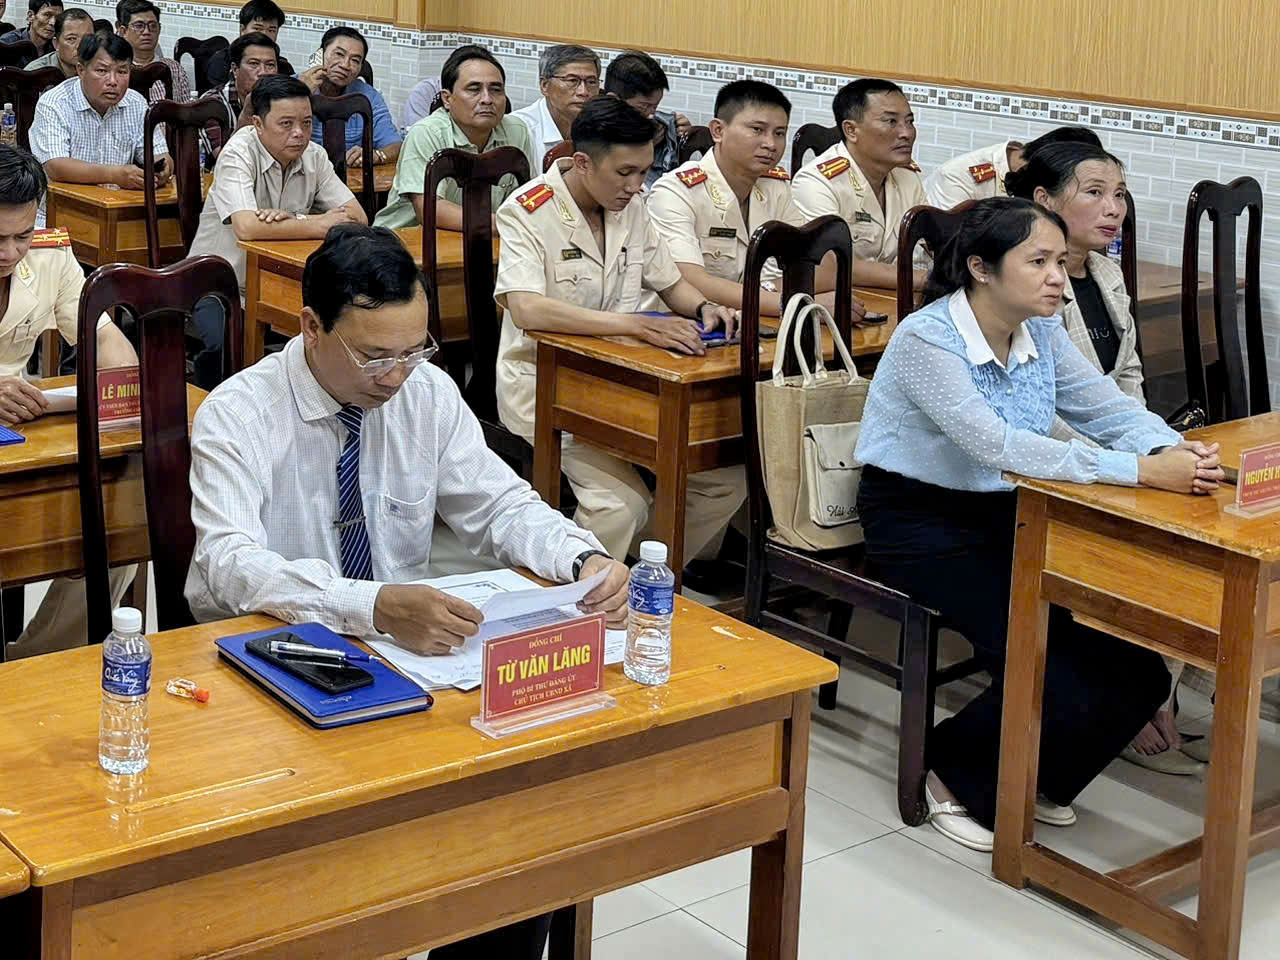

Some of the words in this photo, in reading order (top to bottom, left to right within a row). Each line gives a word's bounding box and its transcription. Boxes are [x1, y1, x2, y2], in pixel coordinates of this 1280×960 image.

[101, 384, 114, 400] LÊ
[497, 659, 518, 685] TỪ
[519, 654, 550, 680] VĂN
[553, 644, 592, 672] LĂNG
